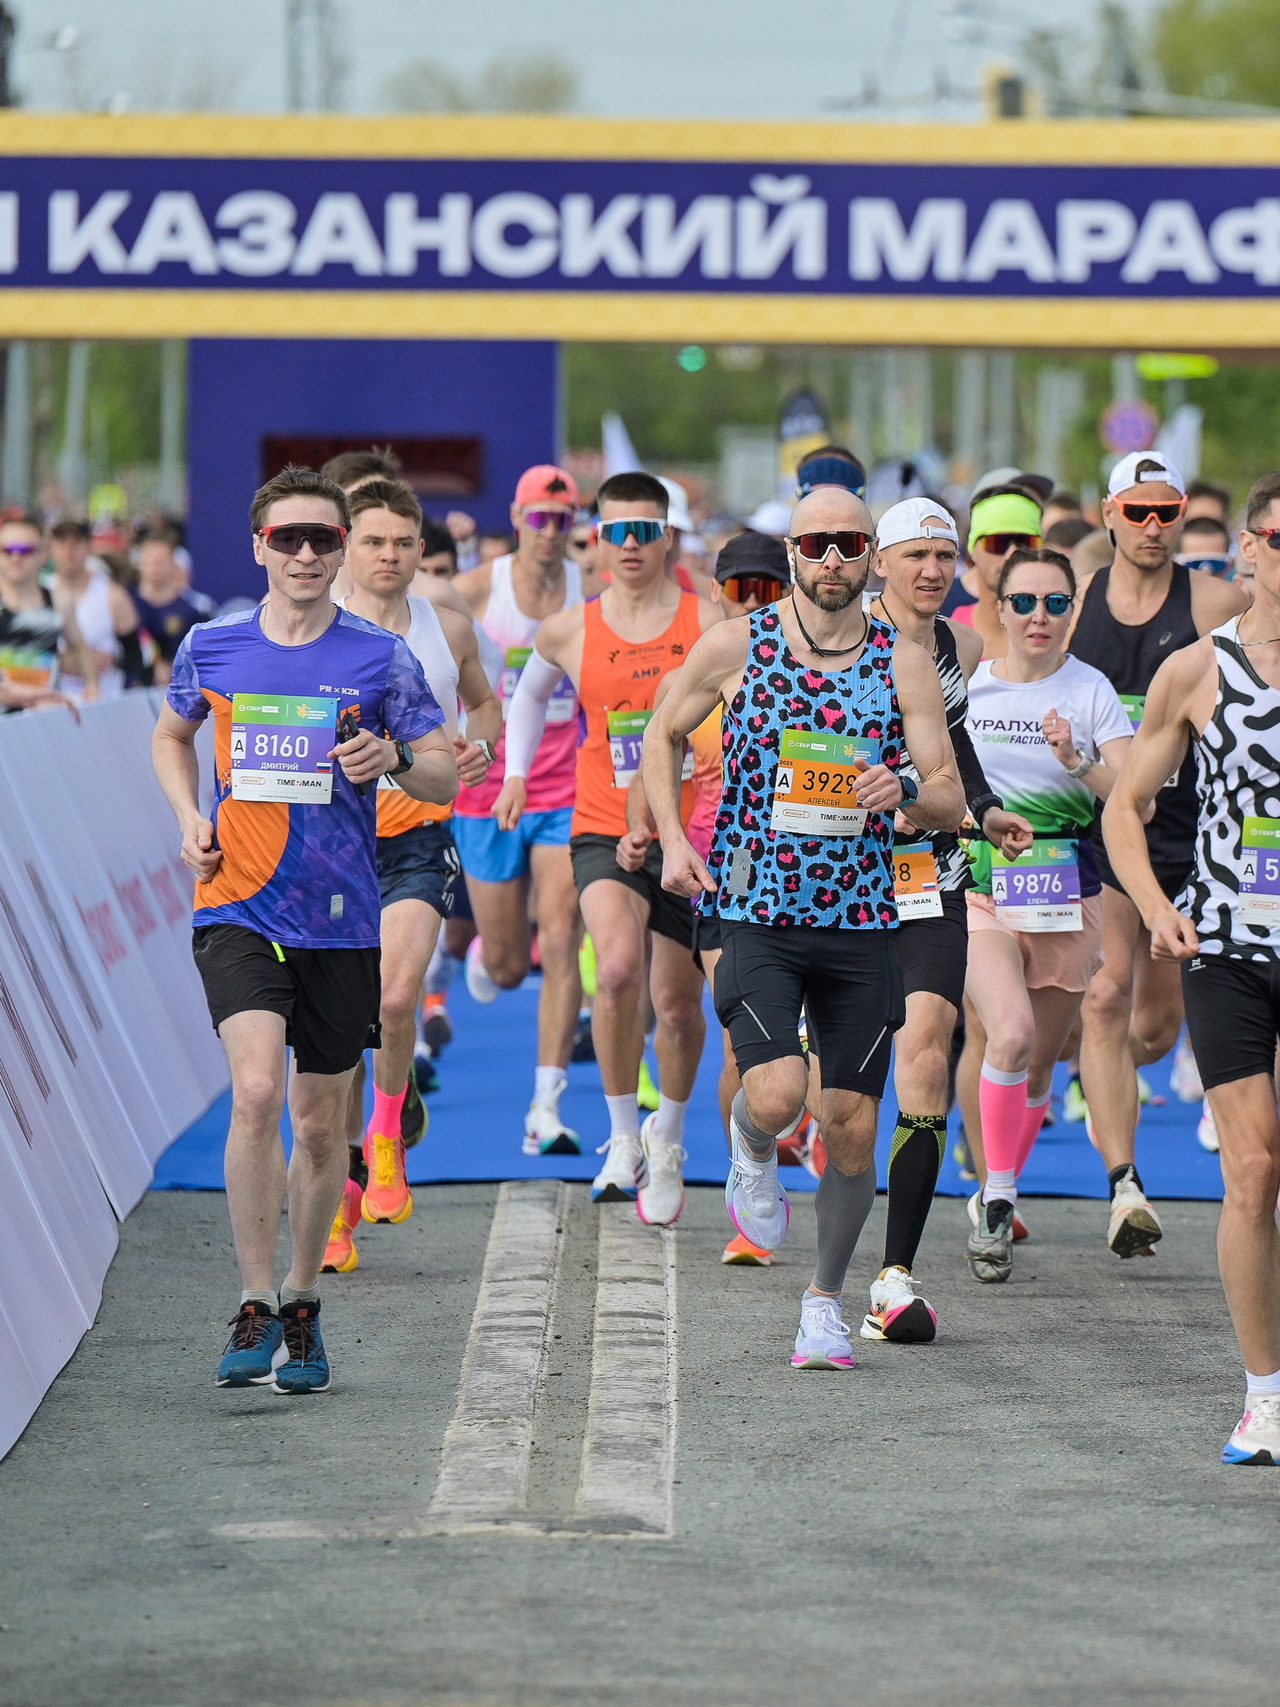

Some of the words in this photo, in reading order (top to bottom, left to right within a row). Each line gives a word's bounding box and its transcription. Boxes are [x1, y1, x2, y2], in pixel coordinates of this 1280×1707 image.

[48, 174, 828, 280] КАЗАНСКИЙ
[631, 667, 660, 680] AMP
[319, 684, 333, 693] PR
[341, 687, 360, 697] KZN
[234, 739, 244, 753] A
[254, 733, 310, 759] 8160
[613, 749, 623, 760] A
[260, 761, 300, 772] ДМИТРИЙ
[778, 773, 790, 788] A
[802, 769, 858, 795] 3929
[807, 797, 840, 807] АЛЕКСЕЙ
[1243, 863, 1255, 876] A
[995, 881, 1005, 893] A
[1012, 873, 1063, 895] 9876
[1026, 897, 1050, 905] ЕЛЕНА
